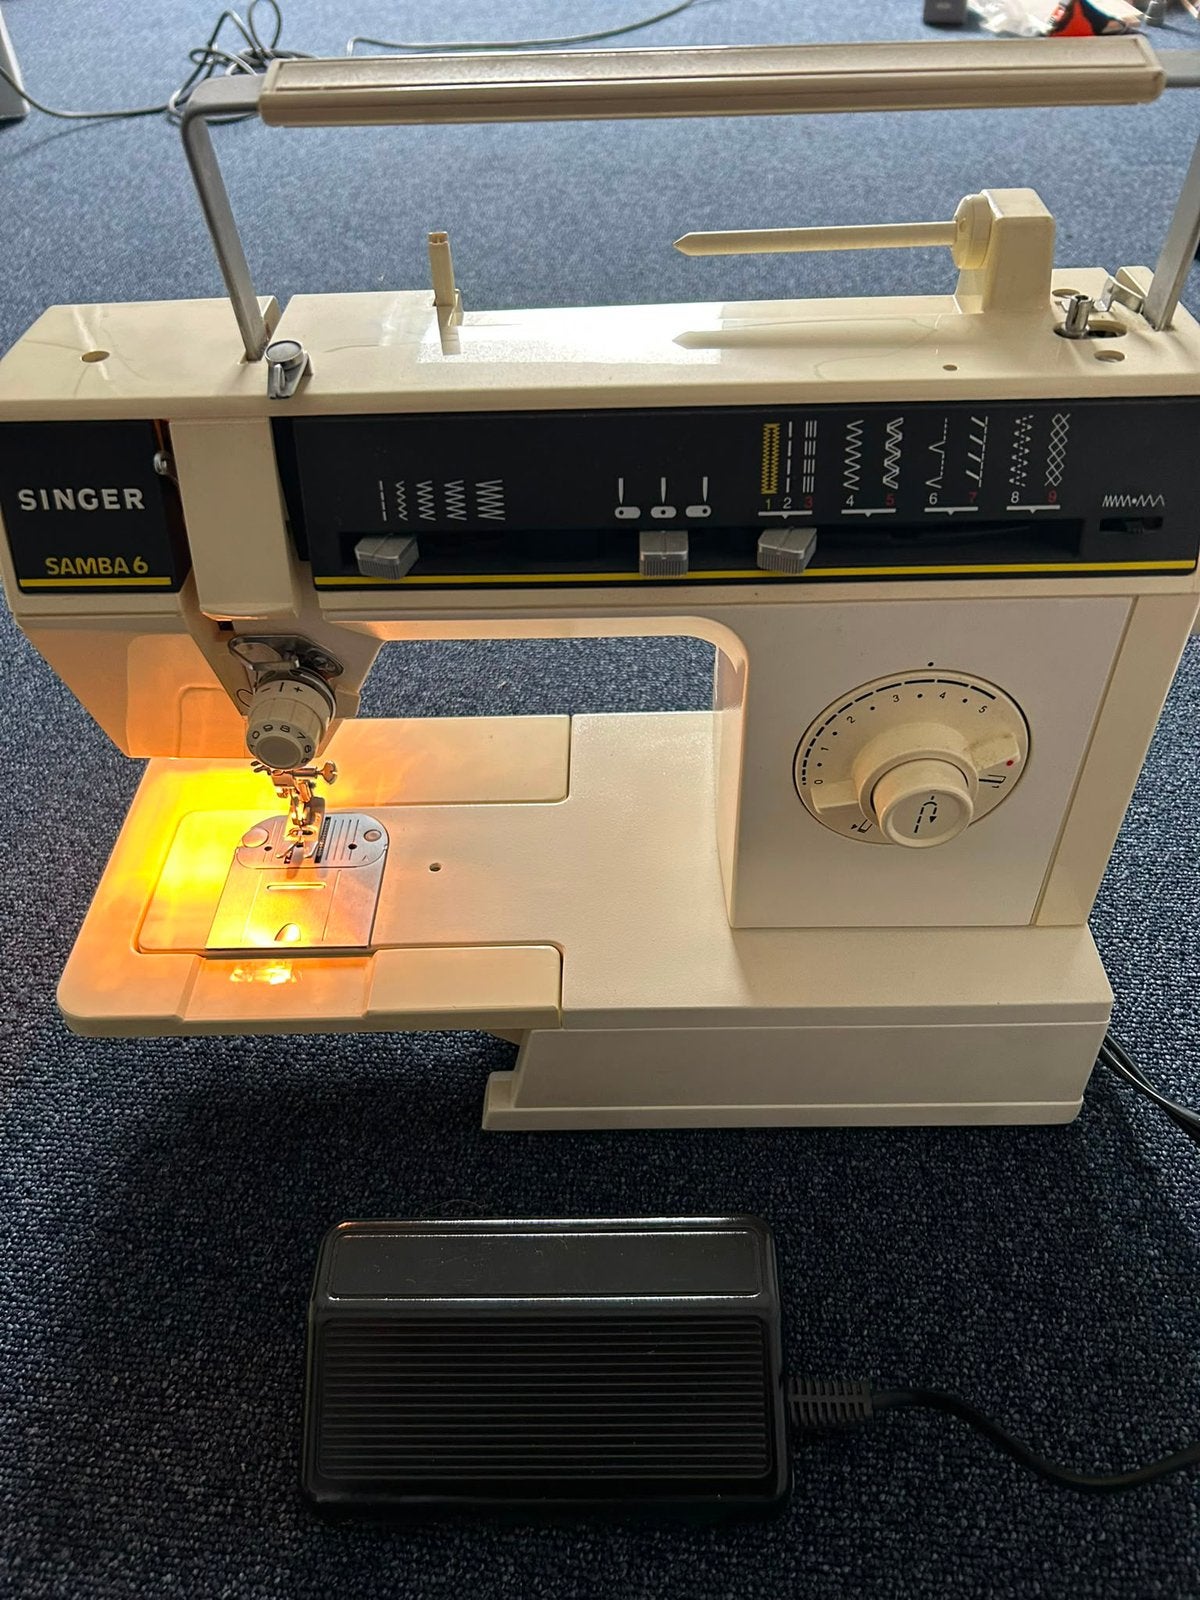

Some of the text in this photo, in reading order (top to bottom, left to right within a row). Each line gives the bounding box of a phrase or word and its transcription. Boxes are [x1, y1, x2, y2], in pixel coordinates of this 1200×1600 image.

[18, 487, 146, 511] SINGER
[765, 495, 813, 511] 1 2 3
[846, 493, 895, 507] 4 5
[928, 491, 977, 505] 6 7
[1010, 491, 1019, 504] 8
[45, 556, 148, 575] SAMBA 6
[846, 715, 856, 724] 2
[892, 694, 900, 703] 3
[939, 691, 946, 699] 4
[978, 705, 988, 714] 5
[280, 724, 291, 733] 8
